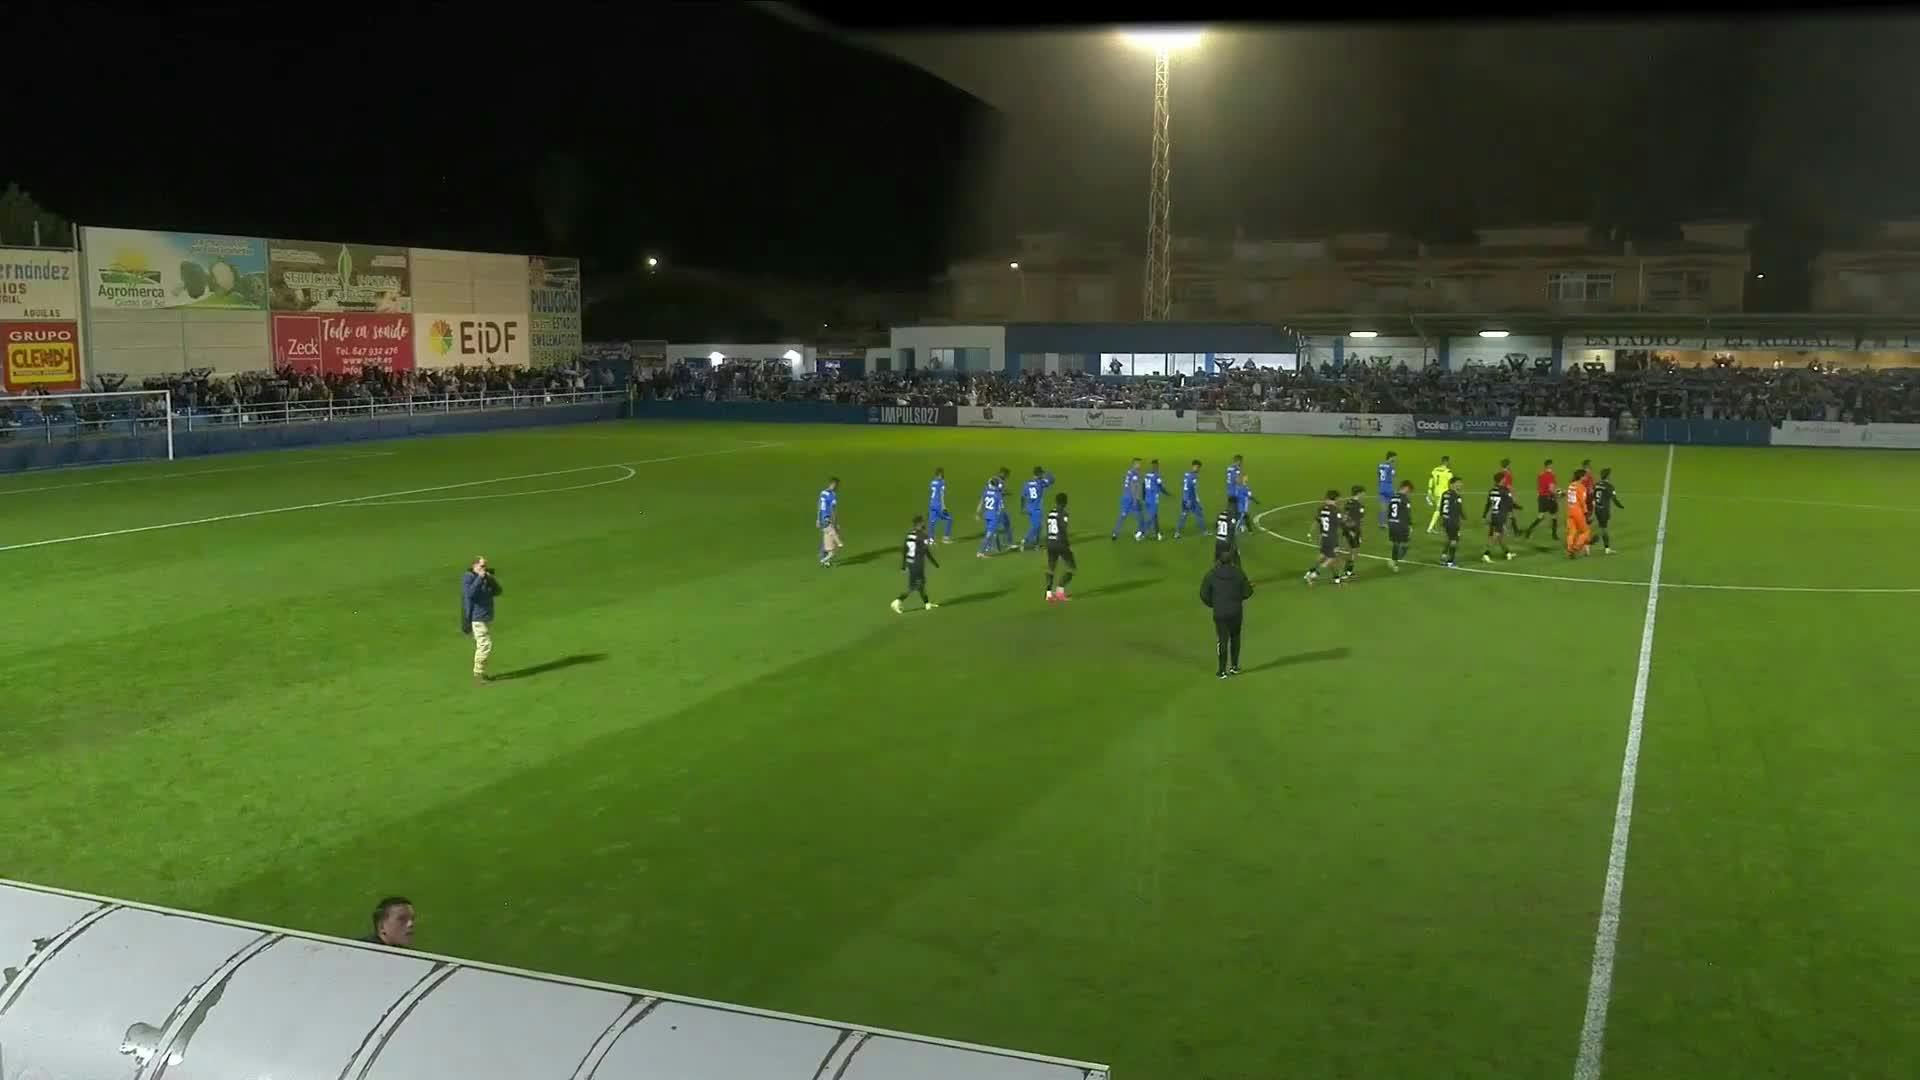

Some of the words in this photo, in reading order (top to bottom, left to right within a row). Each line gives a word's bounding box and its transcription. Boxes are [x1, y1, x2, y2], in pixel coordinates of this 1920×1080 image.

[98, 284, 165, 299] Agromerca
[9, 331, 71, 341] GRUPO
[322, 318, 353, 342] Todo
[355, 325, 369, 339] en
[372, 319, 409, 341] sonido
[460, 321, 517, 354] EiDF
[288, 338, 319, 355] Zeck
[351, 346, 367, 356] 647
[881, 406, 939, 424] IMPULSO27
[1391, 503, 1398, 518] 3
